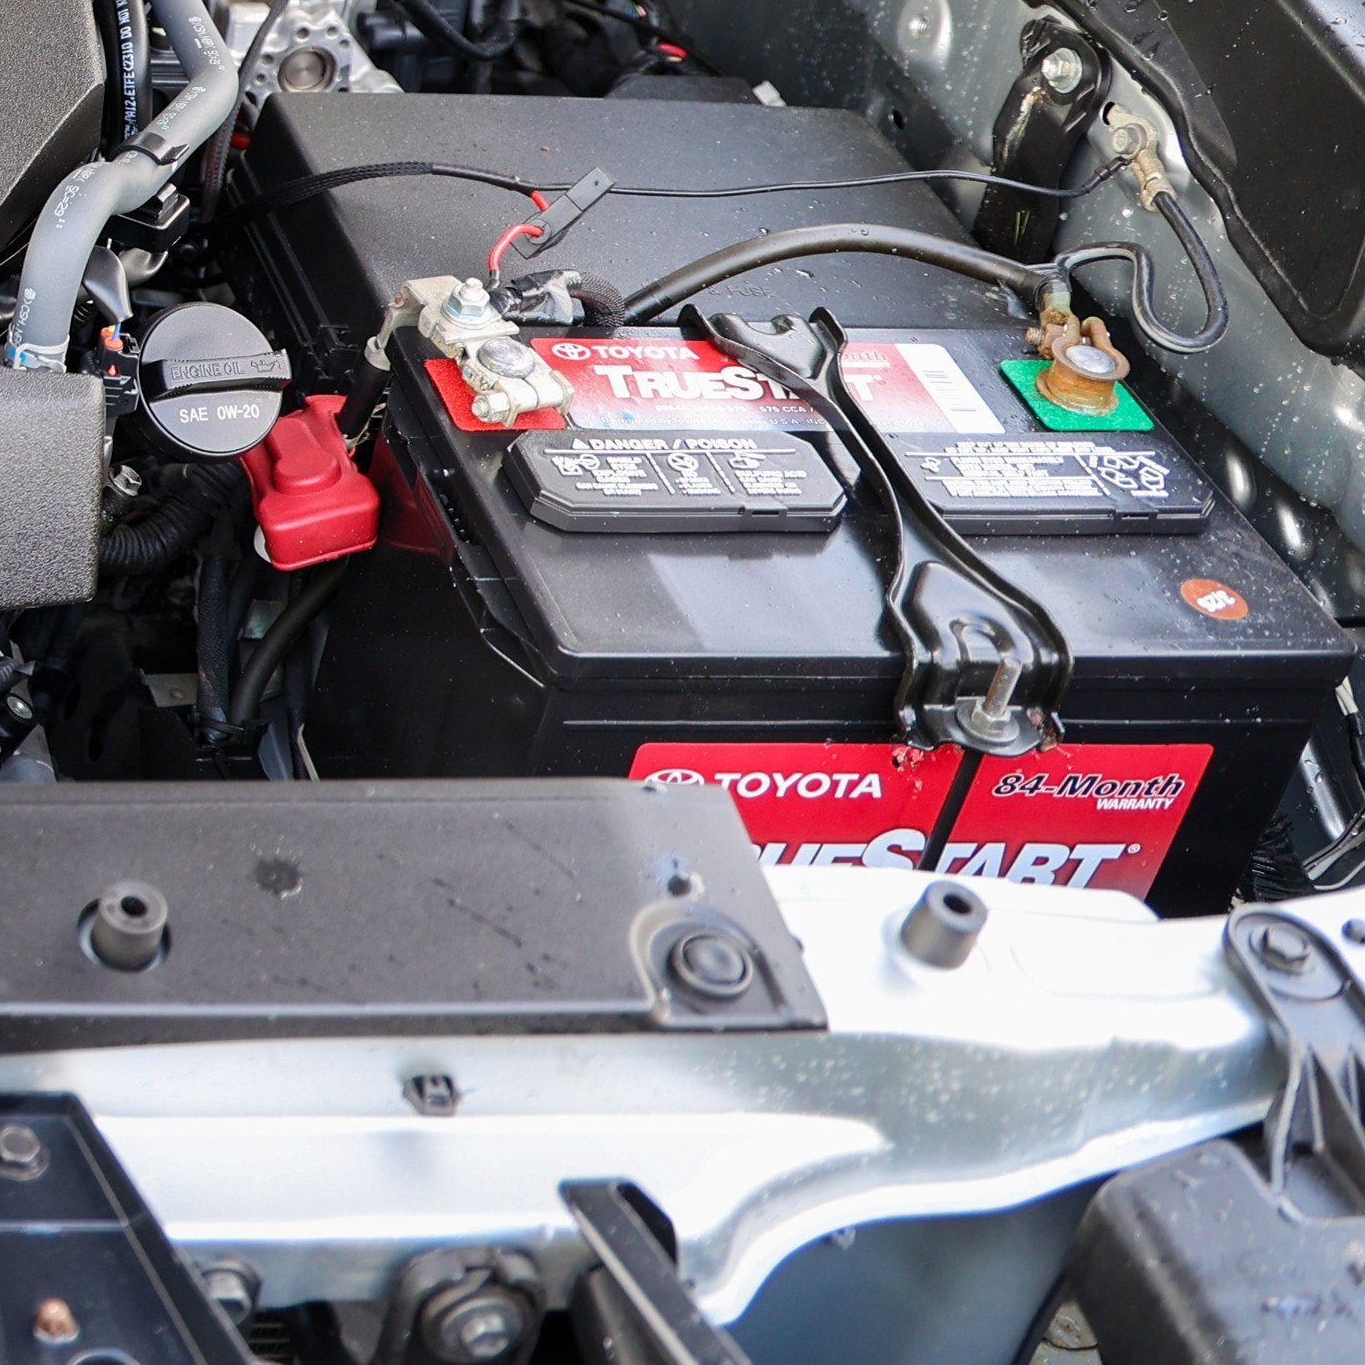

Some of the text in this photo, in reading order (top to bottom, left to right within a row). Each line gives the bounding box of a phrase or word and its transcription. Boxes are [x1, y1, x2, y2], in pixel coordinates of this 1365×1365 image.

[591, 344, 700, 361] TOYOTA
[170, 361, 246, 381] ENGINE OIL
[179, 403, 260, 423] SAE 0W-20
[589, 438, 667, 450] DANGER
[685, 438, 757, 450] POISON
[712, 772, 1186, 799] TOYOTA 84-Month
[1096, 797, 1176, 812] WARRANTY
